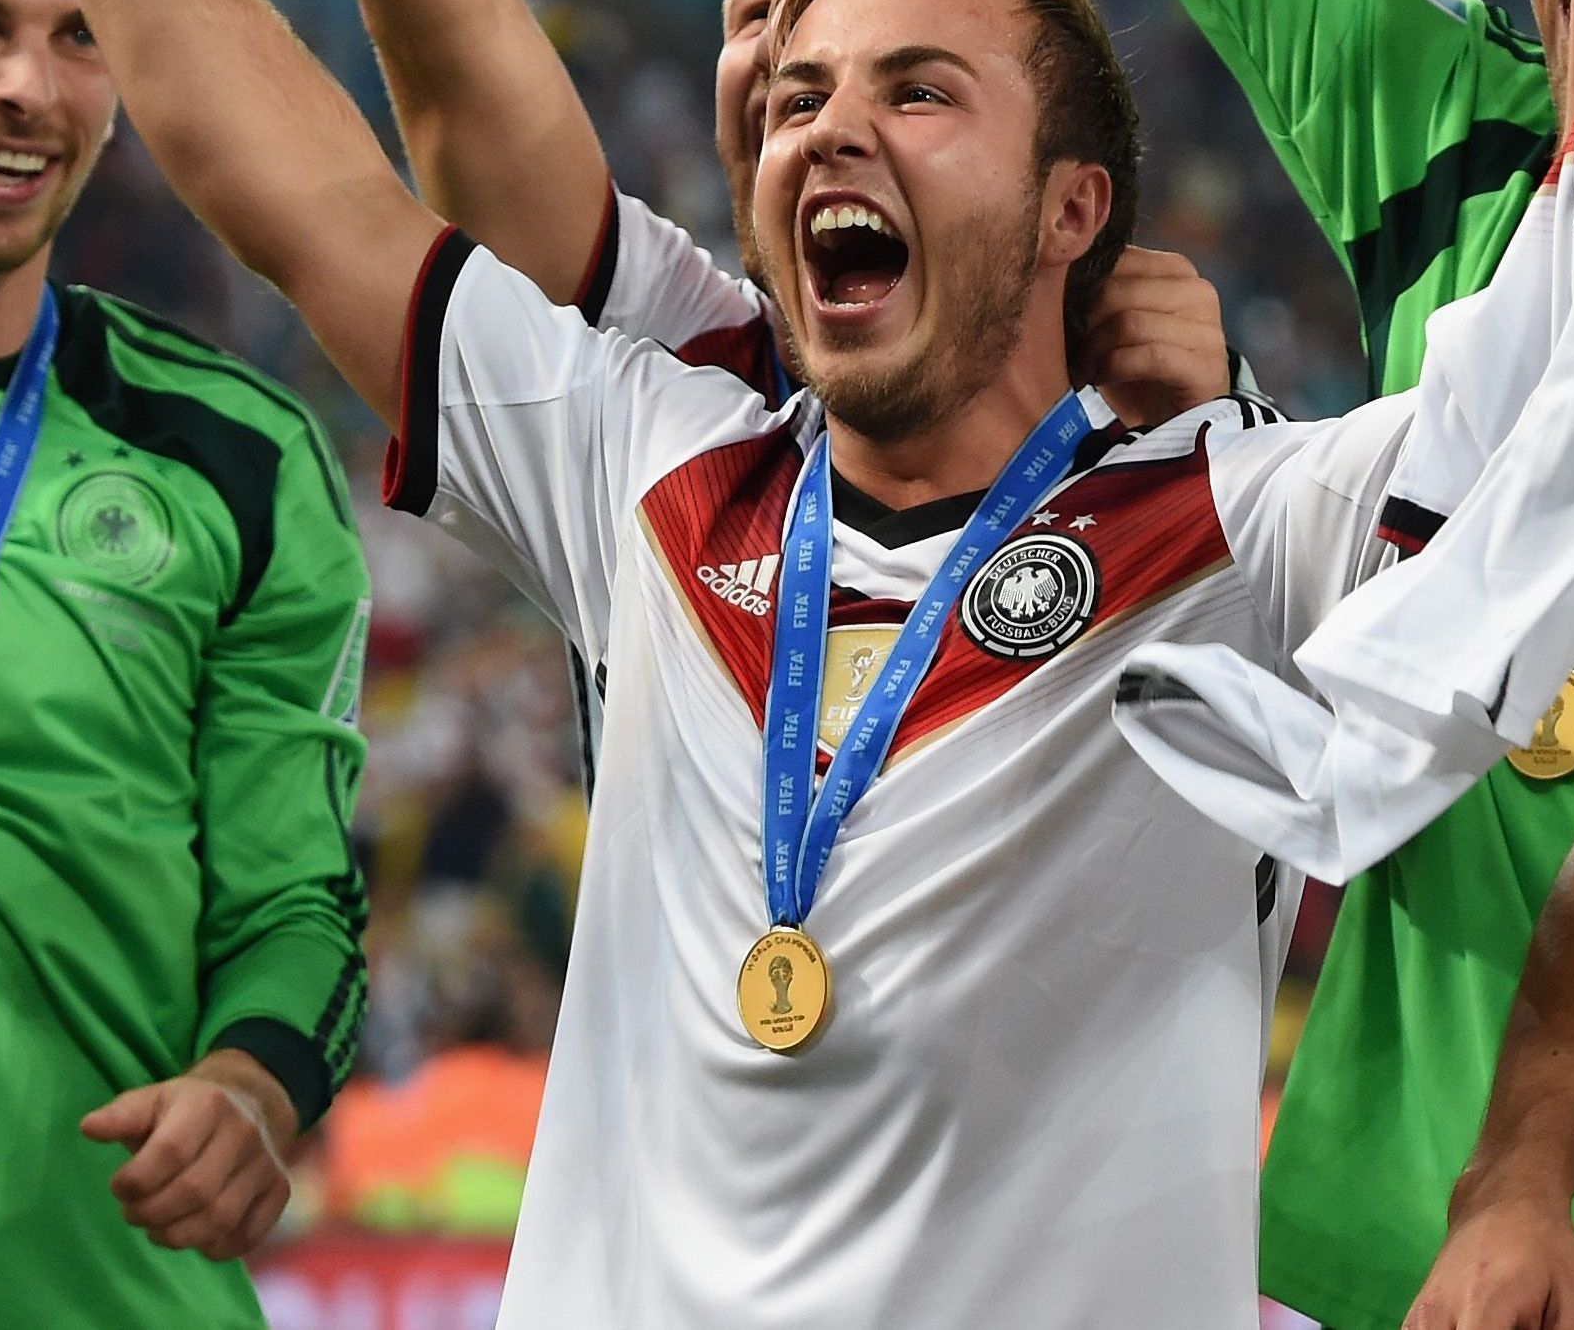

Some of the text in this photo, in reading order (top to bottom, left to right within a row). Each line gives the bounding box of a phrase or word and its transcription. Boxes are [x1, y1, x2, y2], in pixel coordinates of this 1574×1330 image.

[1023, 447, 1054, 481] FIFA
[803, 492, 817, 524] FIFA
[985, 494, 1017, 528] FIFA
[798, 539, 814, 572] FIFA
[950, 546, 980, 578] FIFA
[989, 549, 1062, 580] DEUTSCHER
[696, 565, 771, 616] adidas
[793, 592, 810, 629] FIFA
[916, 600, 945, 636] FIFA
[788, 650, 805, 687] FIFA
[884, 659, 912, 696] FIFA
[782, 710, 799, 750] FIFA
[827, 706, 860, 720] FIF
[851, 717, 879, 752] FIFA
[779, 773, 794, 815] FIFA
[829, 778, 853, 819] FIFA
[775, 840, 790, 884] FIFA
